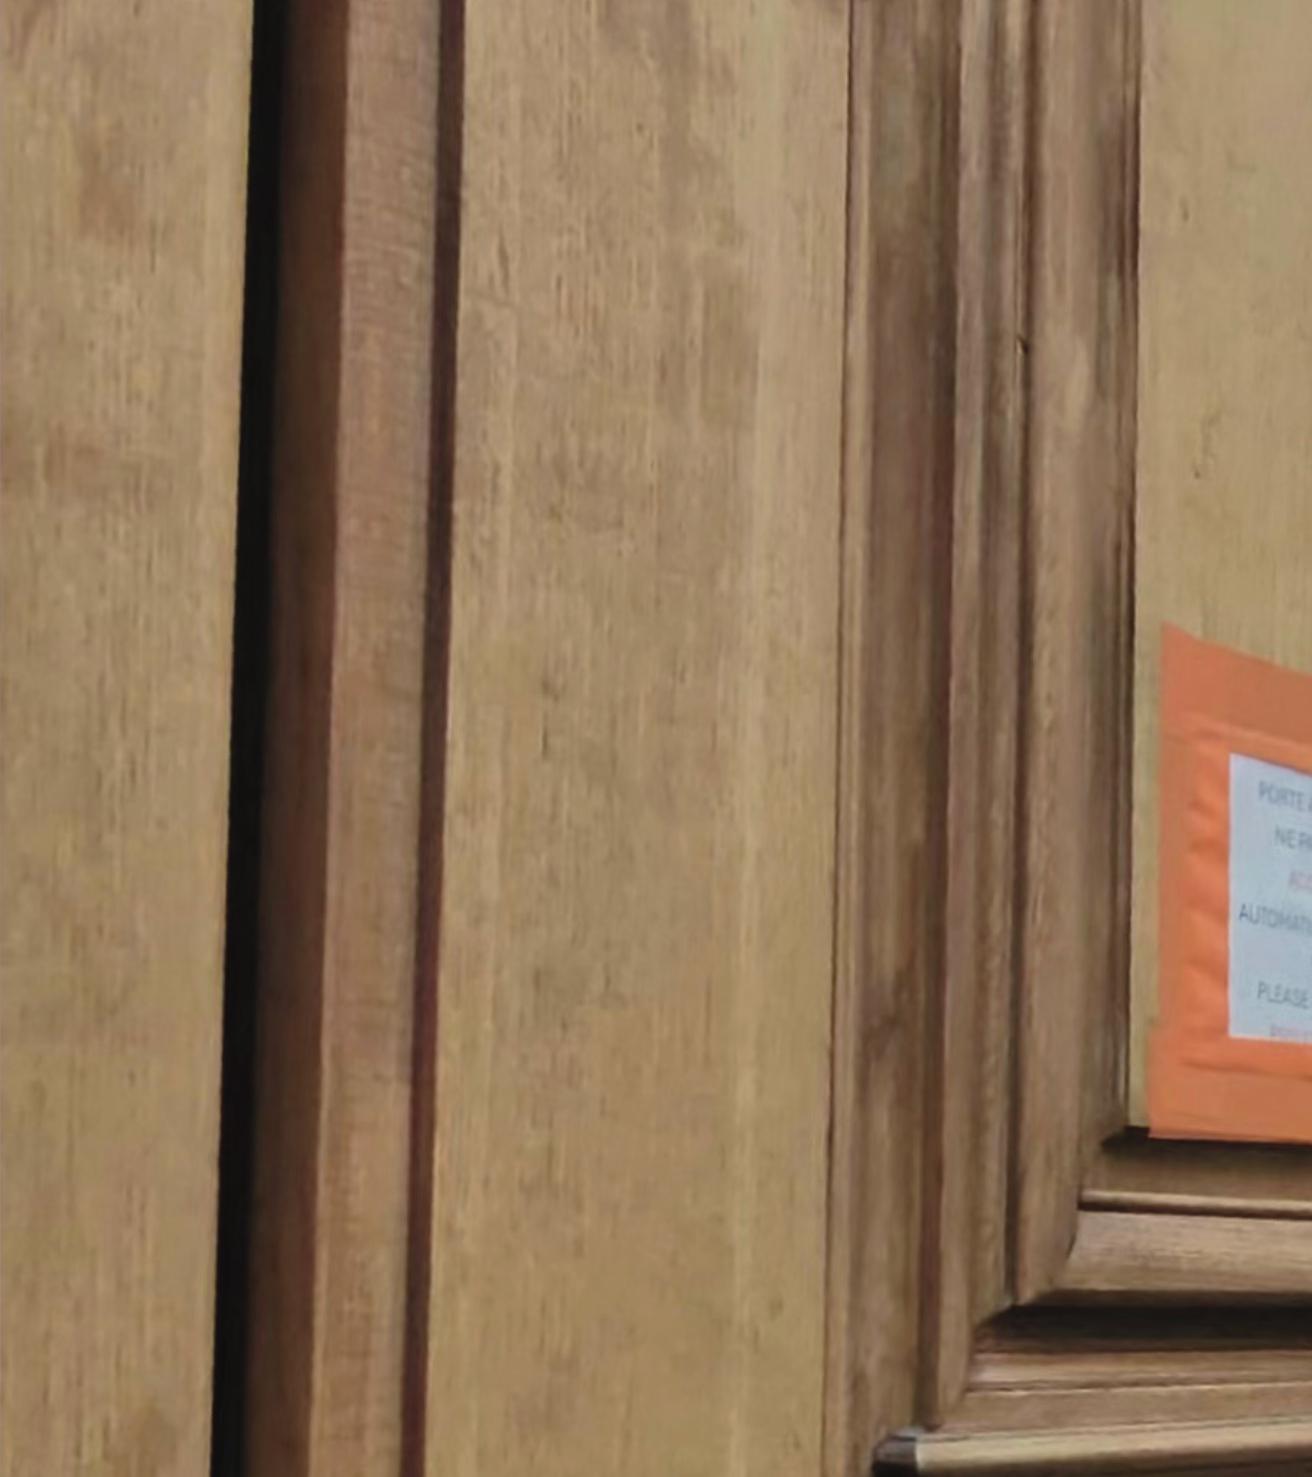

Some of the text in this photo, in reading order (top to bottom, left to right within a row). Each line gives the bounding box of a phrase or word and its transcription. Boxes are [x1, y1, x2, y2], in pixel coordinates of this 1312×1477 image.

[1258, 780, 1305, 812] PORTE
[1274, 824, 1297, 849] NE
[1257, 980, 1310, 1010] PLEASE
